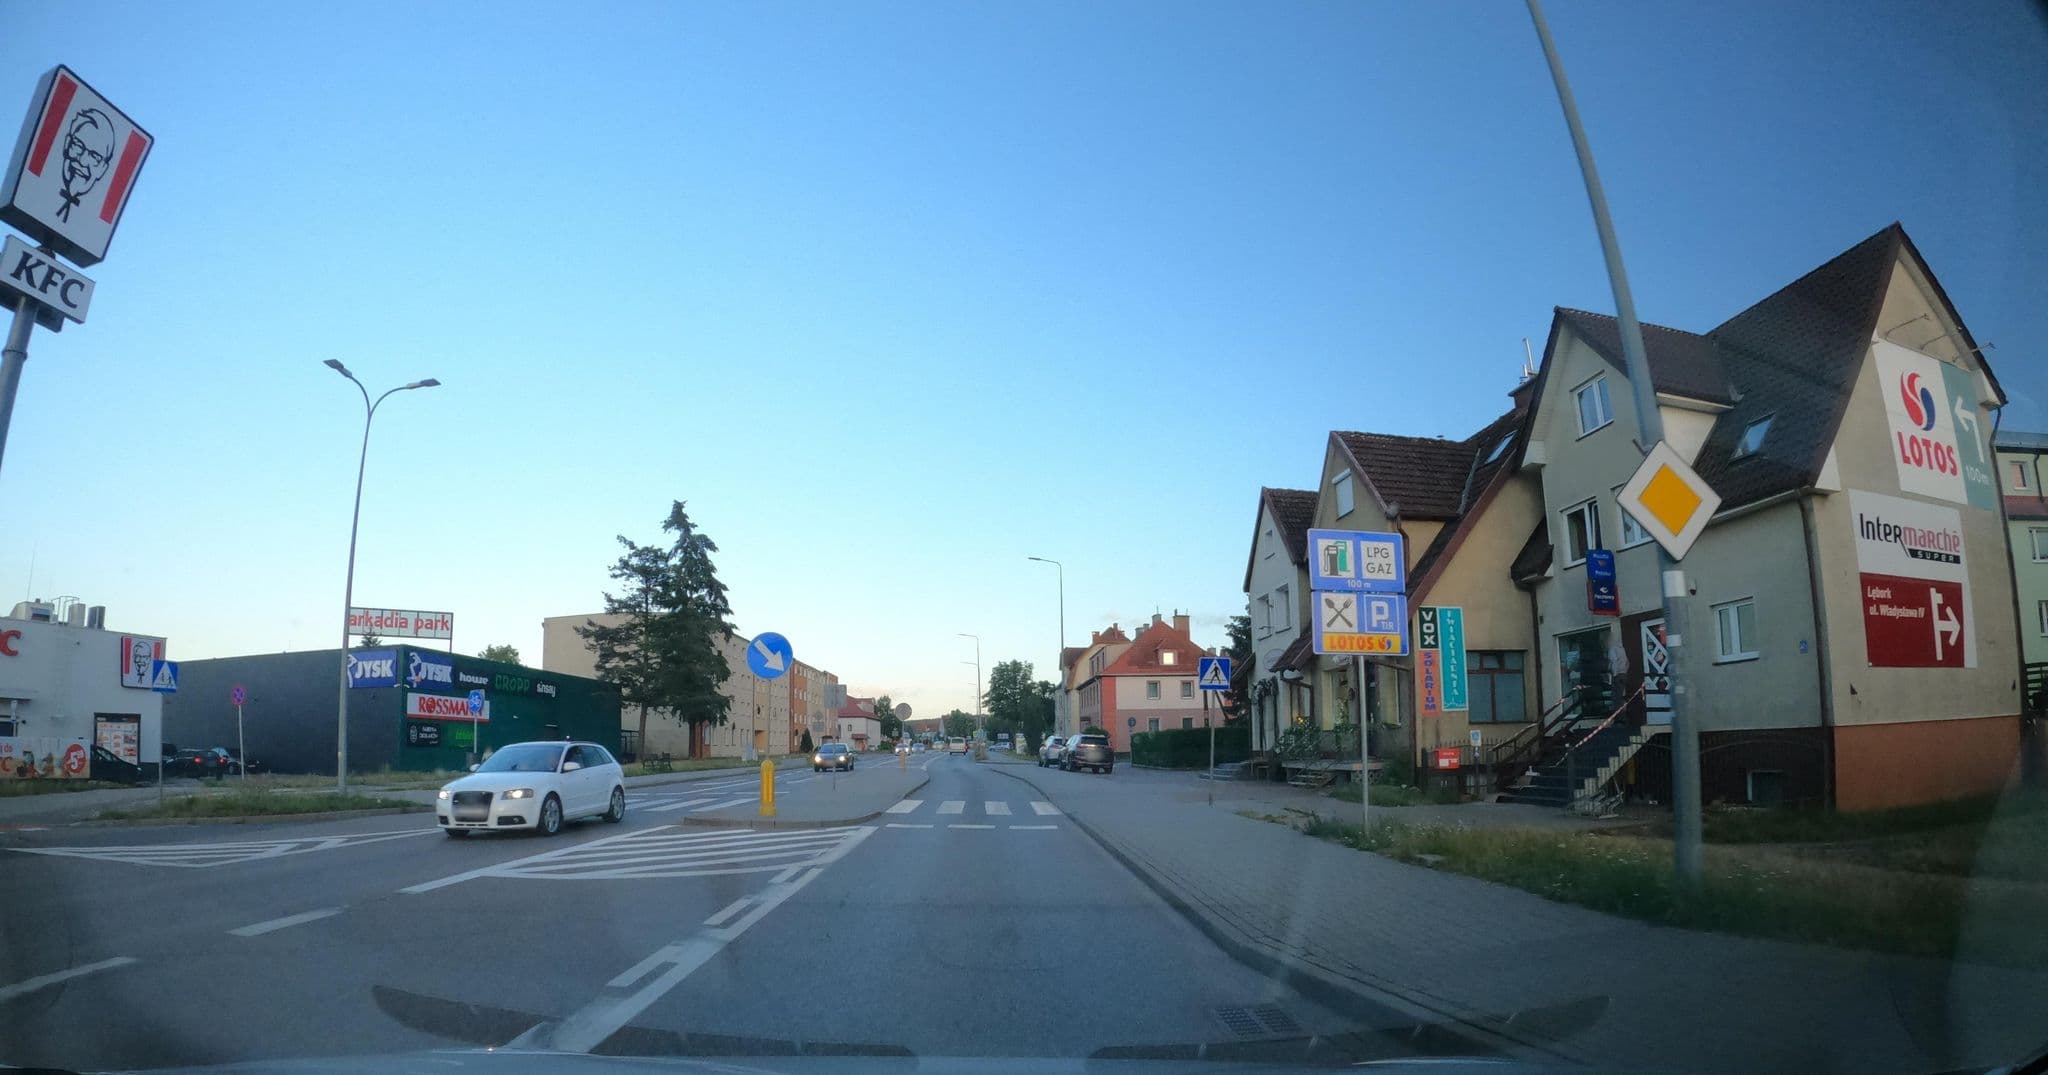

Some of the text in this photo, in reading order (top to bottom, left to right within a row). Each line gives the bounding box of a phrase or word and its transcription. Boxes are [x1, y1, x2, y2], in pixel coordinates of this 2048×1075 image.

[10, 250, 86, 310] KFC
[1897, 431, 1958, 477] LOTOS
[1366, 546, 1390, 559] LPG
[1916, 550, 1955, 563] SUPER
[1366, 562, 1392, 575] GAZ
[1346, 580, 1361, 588] 100
[1867, 585, 1892, 600] Lębork
[1371, 601, 1389, 628] P
[1869, 604, 1880, 616] ul.
[1879, 604, 1918, 619] Władysława
[350, 610, 450, 633] arkadia park
[1381, 621, 1394, 631] TIR
[1422, 610, 1436, 646] VOX
[1328, 635, 1375, 651] LOTOS
[354, 659, 394, 679] JYSK
[420, 662, 453, 683] JYSK
[459, 671, 489, 685] house
[495, 674, 530, 692] CROPP
[536, 680, 556, 698] sinsay
